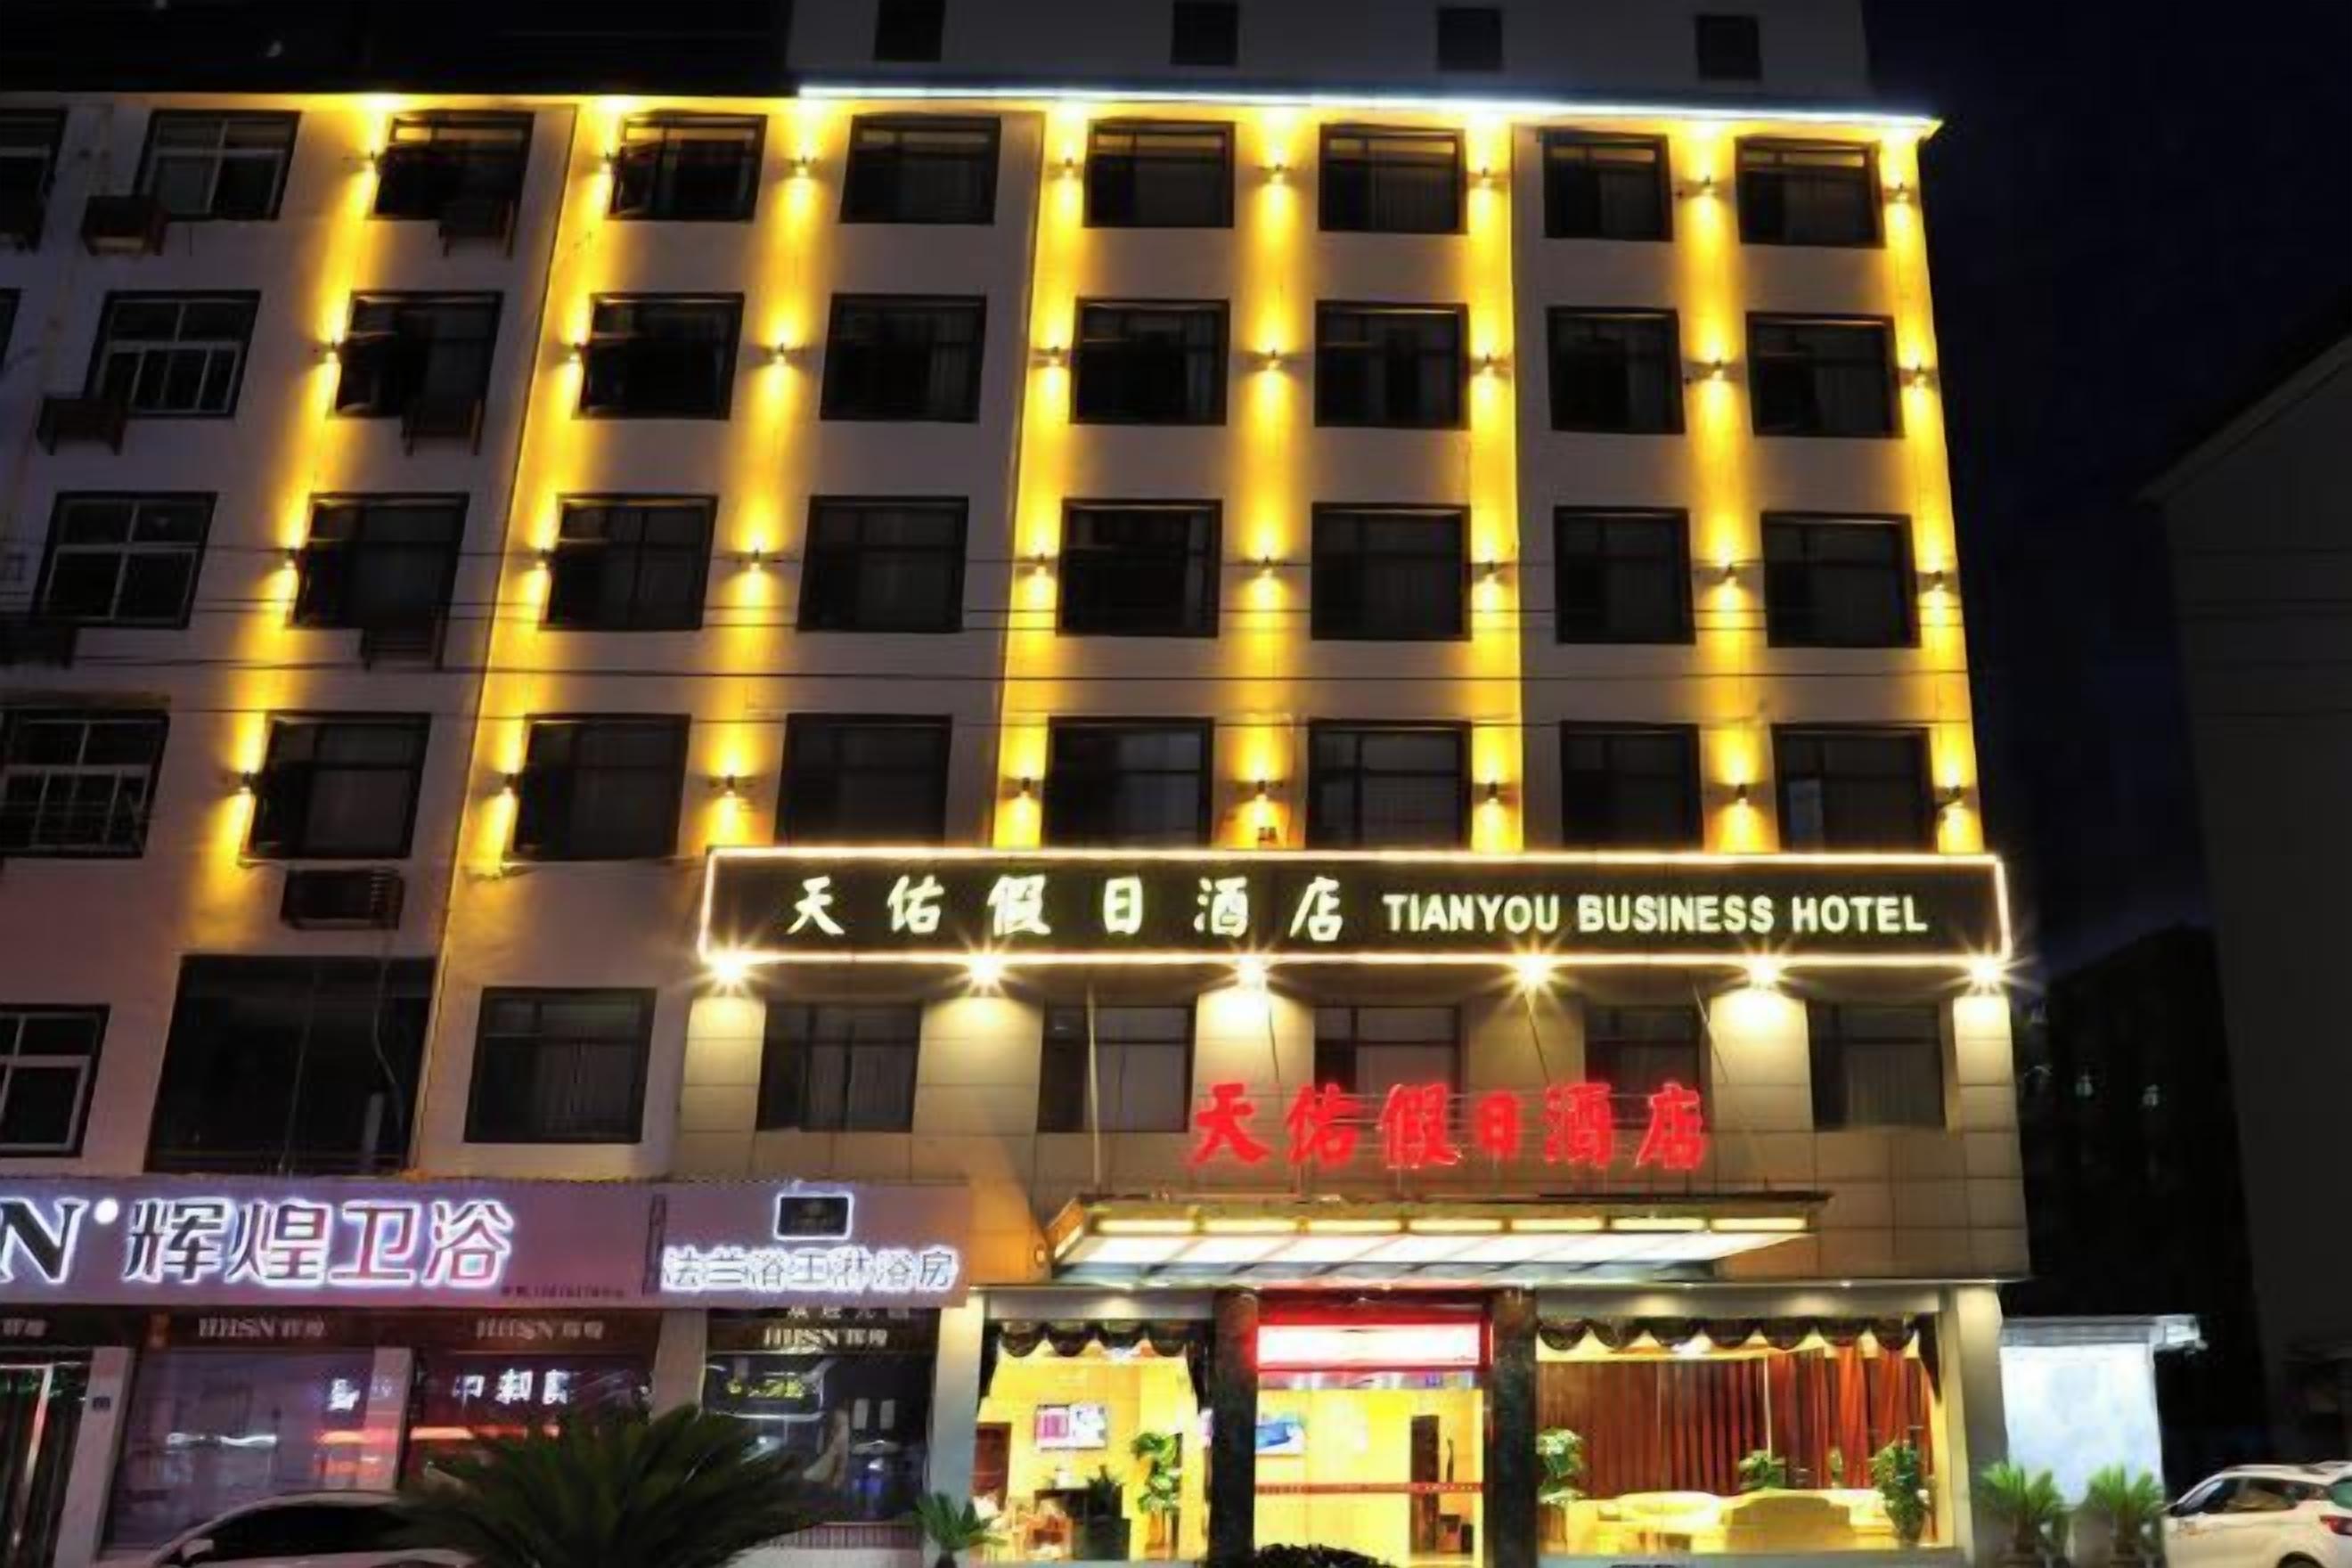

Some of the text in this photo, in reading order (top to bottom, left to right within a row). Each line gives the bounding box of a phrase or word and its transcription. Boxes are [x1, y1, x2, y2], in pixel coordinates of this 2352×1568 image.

[787, 874, 1343, 943] 天佑假日酒店
[1382, 894, 1927, 934] TIANYOU BUSINESS HOTEL
[1190, 1082, 1707, 1169] 天佑假日酒店
[122, 1196, 515, 1289] 辉煌卫浴
